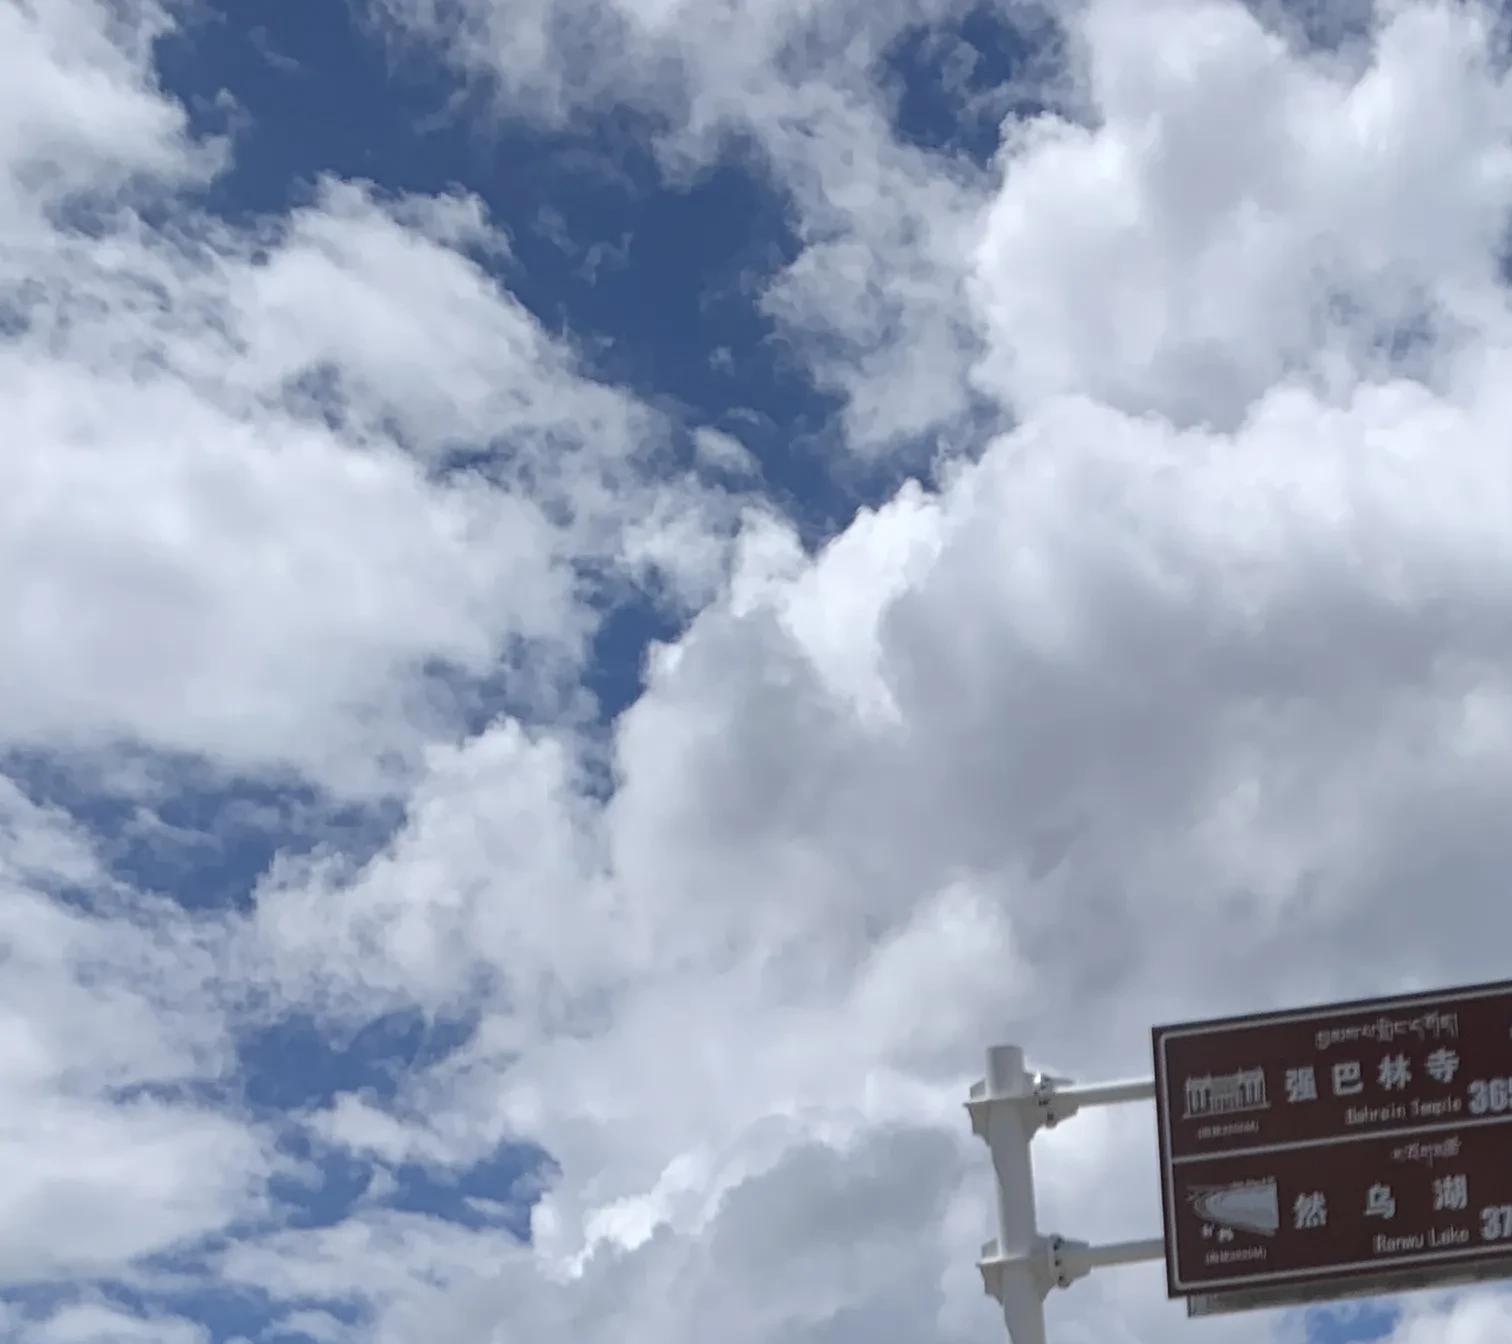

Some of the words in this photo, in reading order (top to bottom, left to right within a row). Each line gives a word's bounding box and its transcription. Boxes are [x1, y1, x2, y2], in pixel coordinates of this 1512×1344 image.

[1285, 1047, 1460, 1103] 强巴林寺
[1294, 1175, 1468, 1229] 然乌湖
[1430, 1227, 1470, 1249] Lake
